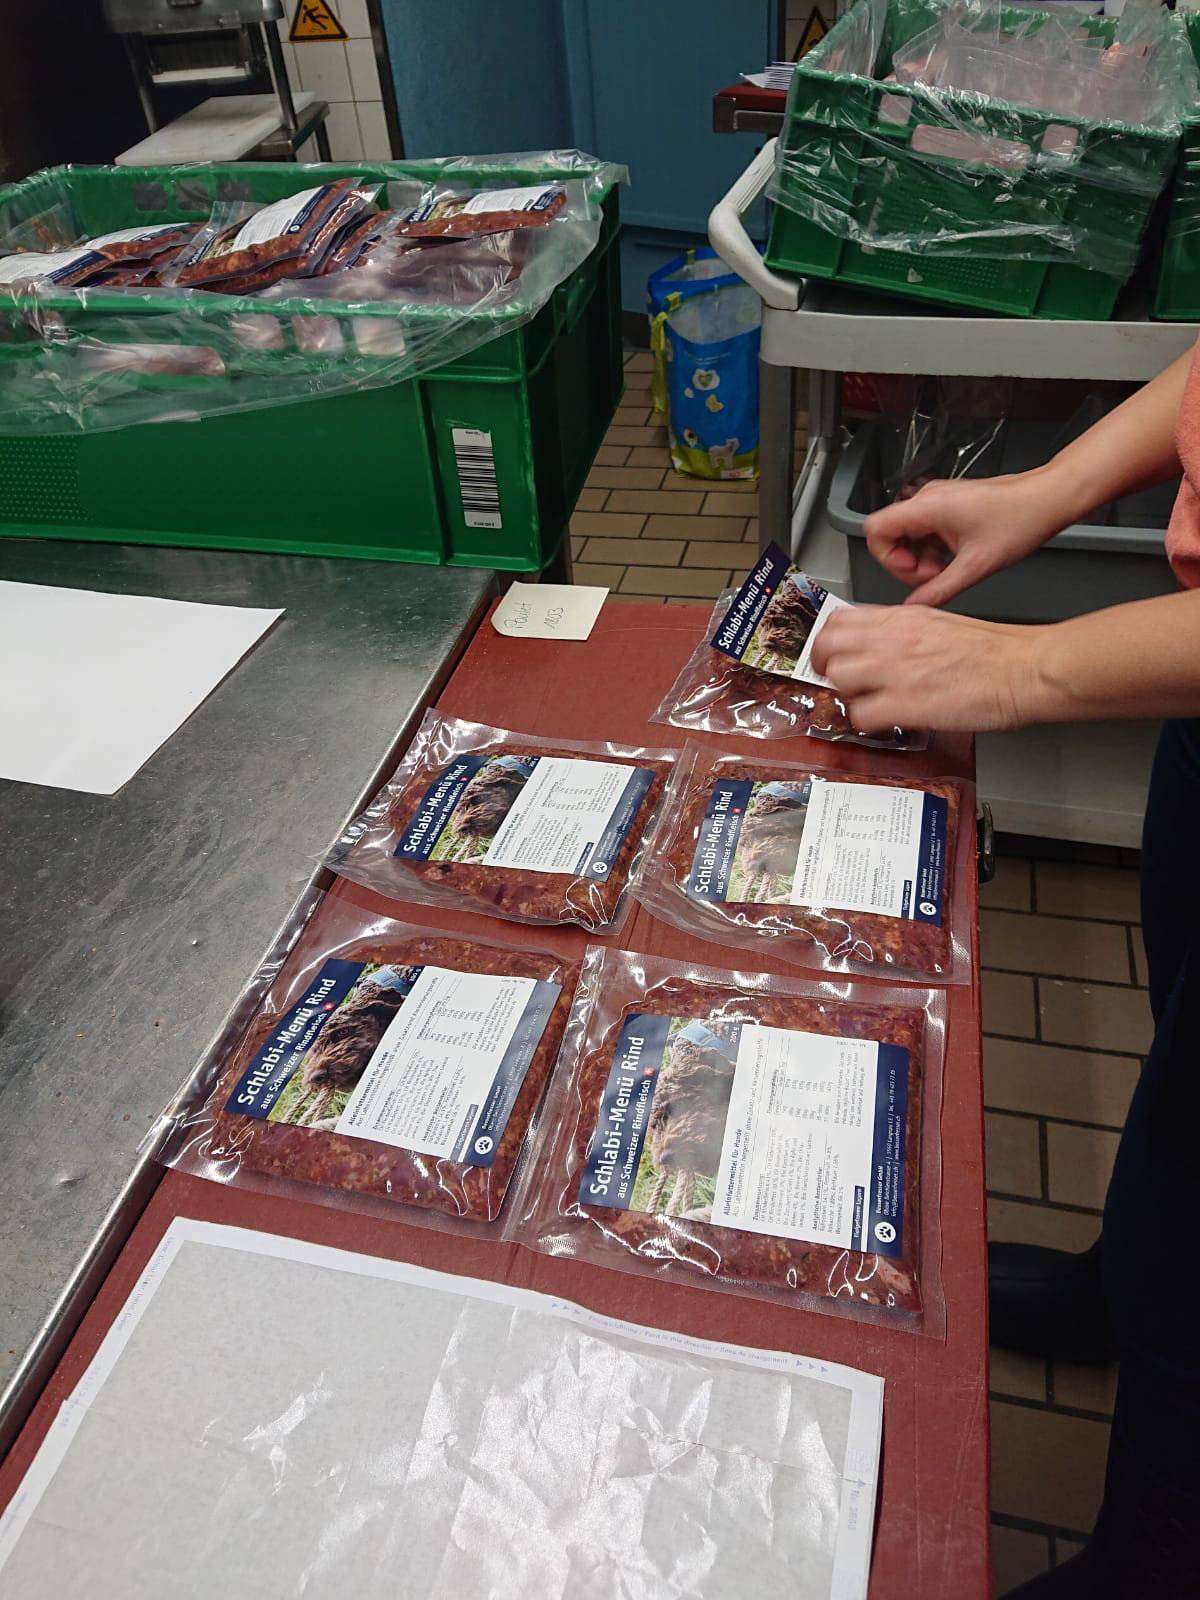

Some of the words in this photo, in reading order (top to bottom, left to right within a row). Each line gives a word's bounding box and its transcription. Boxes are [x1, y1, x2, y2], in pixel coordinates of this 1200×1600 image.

[718, 584, 760, 650] Schlabi-Menü
[754, 558, 774, 586] Rind
[734, 645, 742, 655] aus
[403, 781, 453, 852] Schlabi-Menü
[445, 764, 468, 781] Rind
[422, 844, 431, 854] aus
[427, 813, 447, 842] Schweizer
[442, 782, 464, 812] Rindfleisch
[725, 815, 739, 847] Rindfleisch
[694, 814, 726, 893] Schlabi-Menü
[715, 791, 733, 811] Rind
[718, 848, 732, 880] Schweizer
[716, 881, 724, 893] aus
[237, 1007, 314, 1105] Schlabi-Menü
[305, 978, 337, 1005] Rind
[260, 1093, 273, 1110] aus
[269, 1052, 301, 1091] Schweizer
[295, 1013, 327, 1051] Rindfleisch
[590, 1076, 634, 1195] Schlabi-Menü
[621, 1036, 645, 1071] Rind
[632, 1079, 652, 1130] Rindfleisch
[620, 1131, 640, 1180] Schweizer
[617, 1181, 629, 1199] aus
